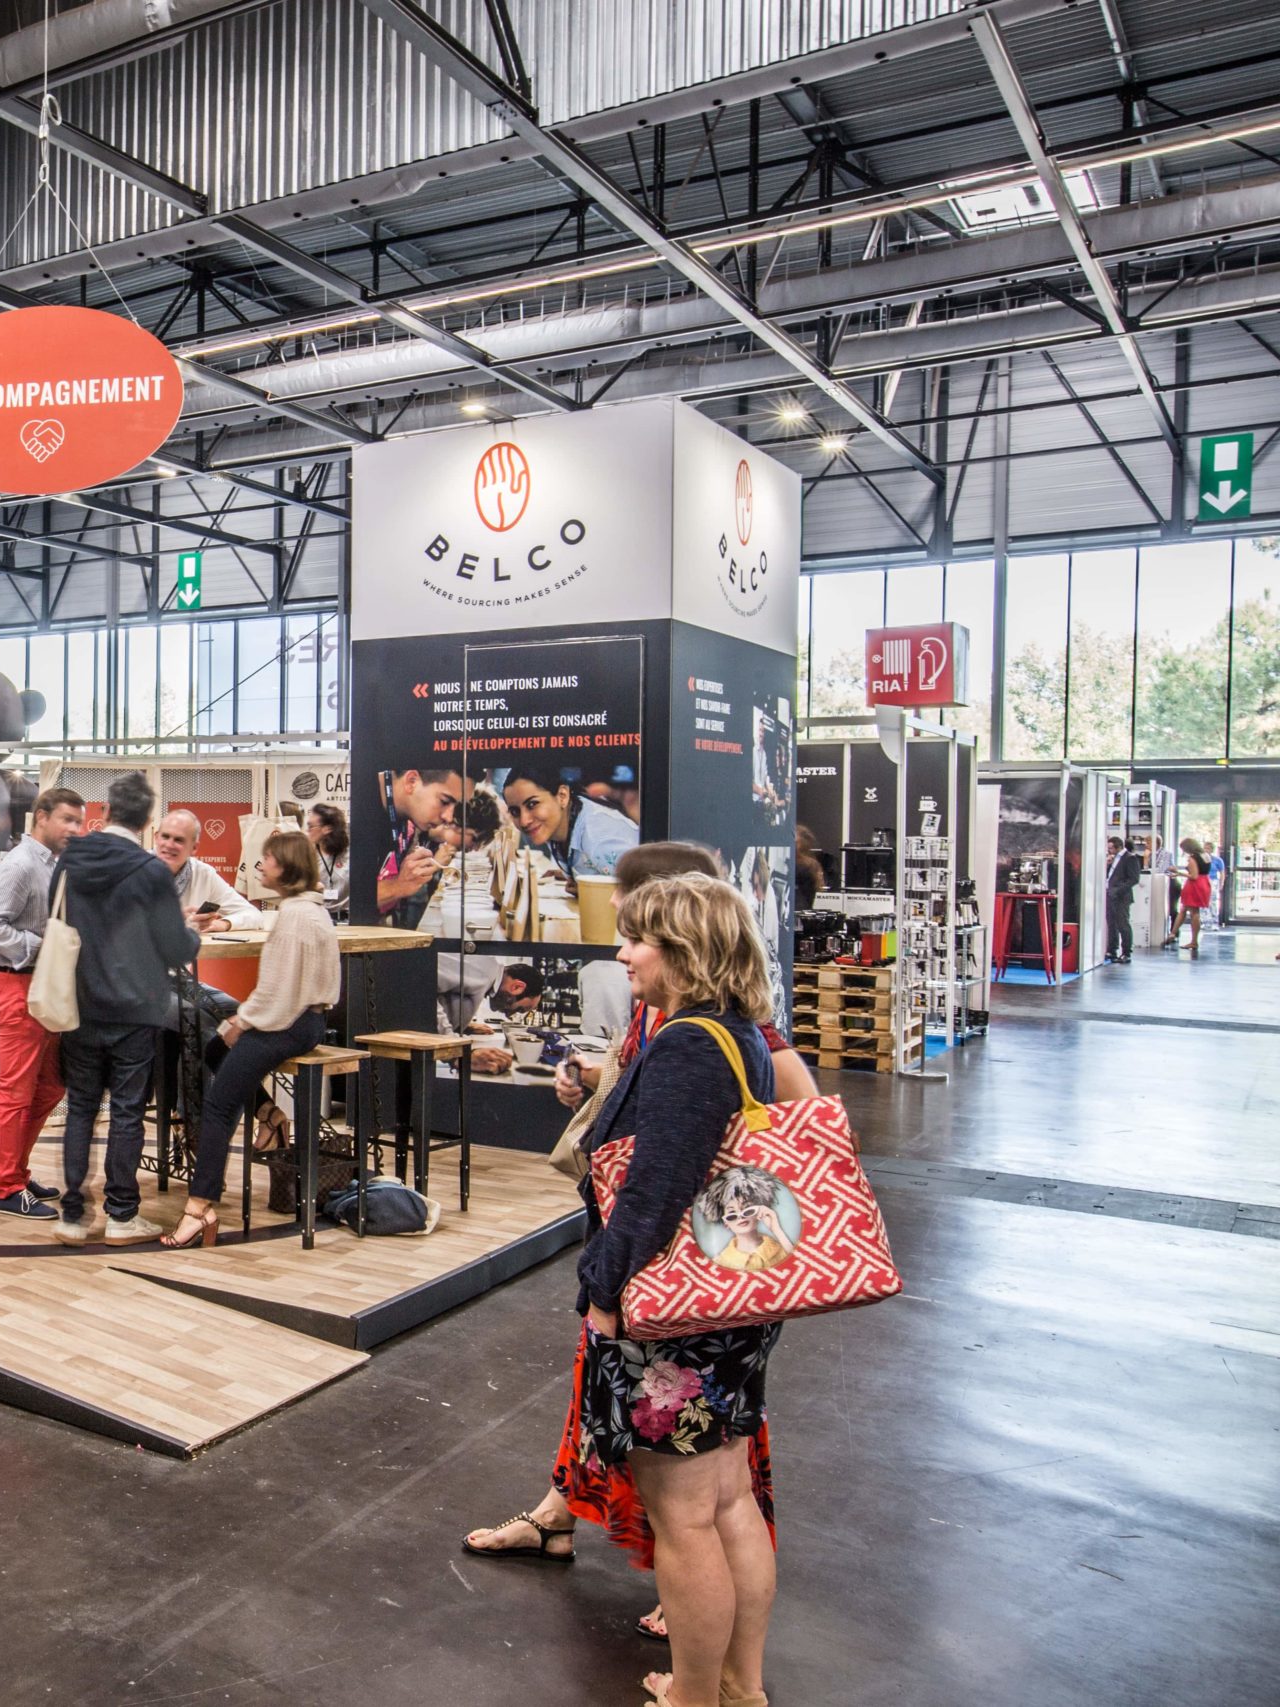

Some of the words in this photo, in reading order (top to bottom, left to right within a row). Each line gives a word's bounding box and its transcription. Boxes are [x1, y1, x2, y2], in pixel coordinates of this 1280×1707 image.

[424, 519, 586, 582] BELCO
[719, 533, 767, 594] BELCO
[422, 578, 454, 601] WHERE
[457, 596, 510, 607] SOURCING
[515, 587, 551, 604] MAKES
[554, 564, 588, 590] SENSE
[434, 682, 460, 695] NOUS
[470, 680, 482, 693] NE
[485, 677, 538, 692] COMPTONS
[541, 676, 578, 689] JAMAIS
[872, 680, 901, 694] RIA
[475, 699, 508, 712] TEMPS,
[487, 716, 529, 730] CELUI-CI
[532, 715, 549, 728] EST
[553, 710, 607, 727] CONSACRÉ
[434, 740, 447, 751] AU
[550, 736, 564, 748] DE
[568, 735, 590, 747] NOS
[594, 733, 641, 746] CLIENTS
